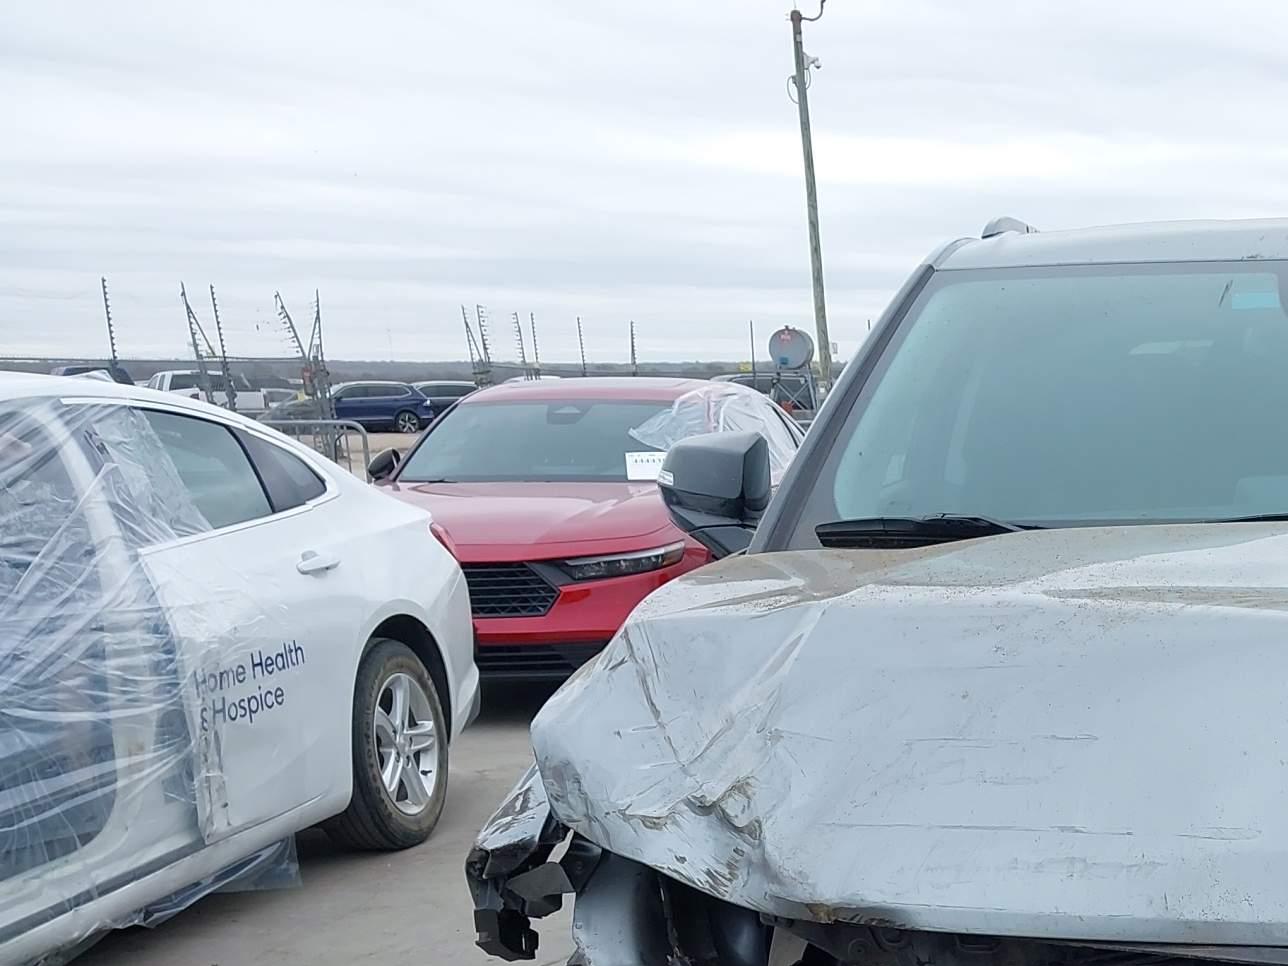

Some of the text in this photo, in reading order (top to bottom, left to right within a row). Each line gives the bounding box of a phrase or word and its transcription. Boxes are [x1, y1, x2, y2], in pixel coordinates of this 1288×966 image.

[194, 639, 305, 699] Home Health
[212, 685, 285, 725] Hospice
